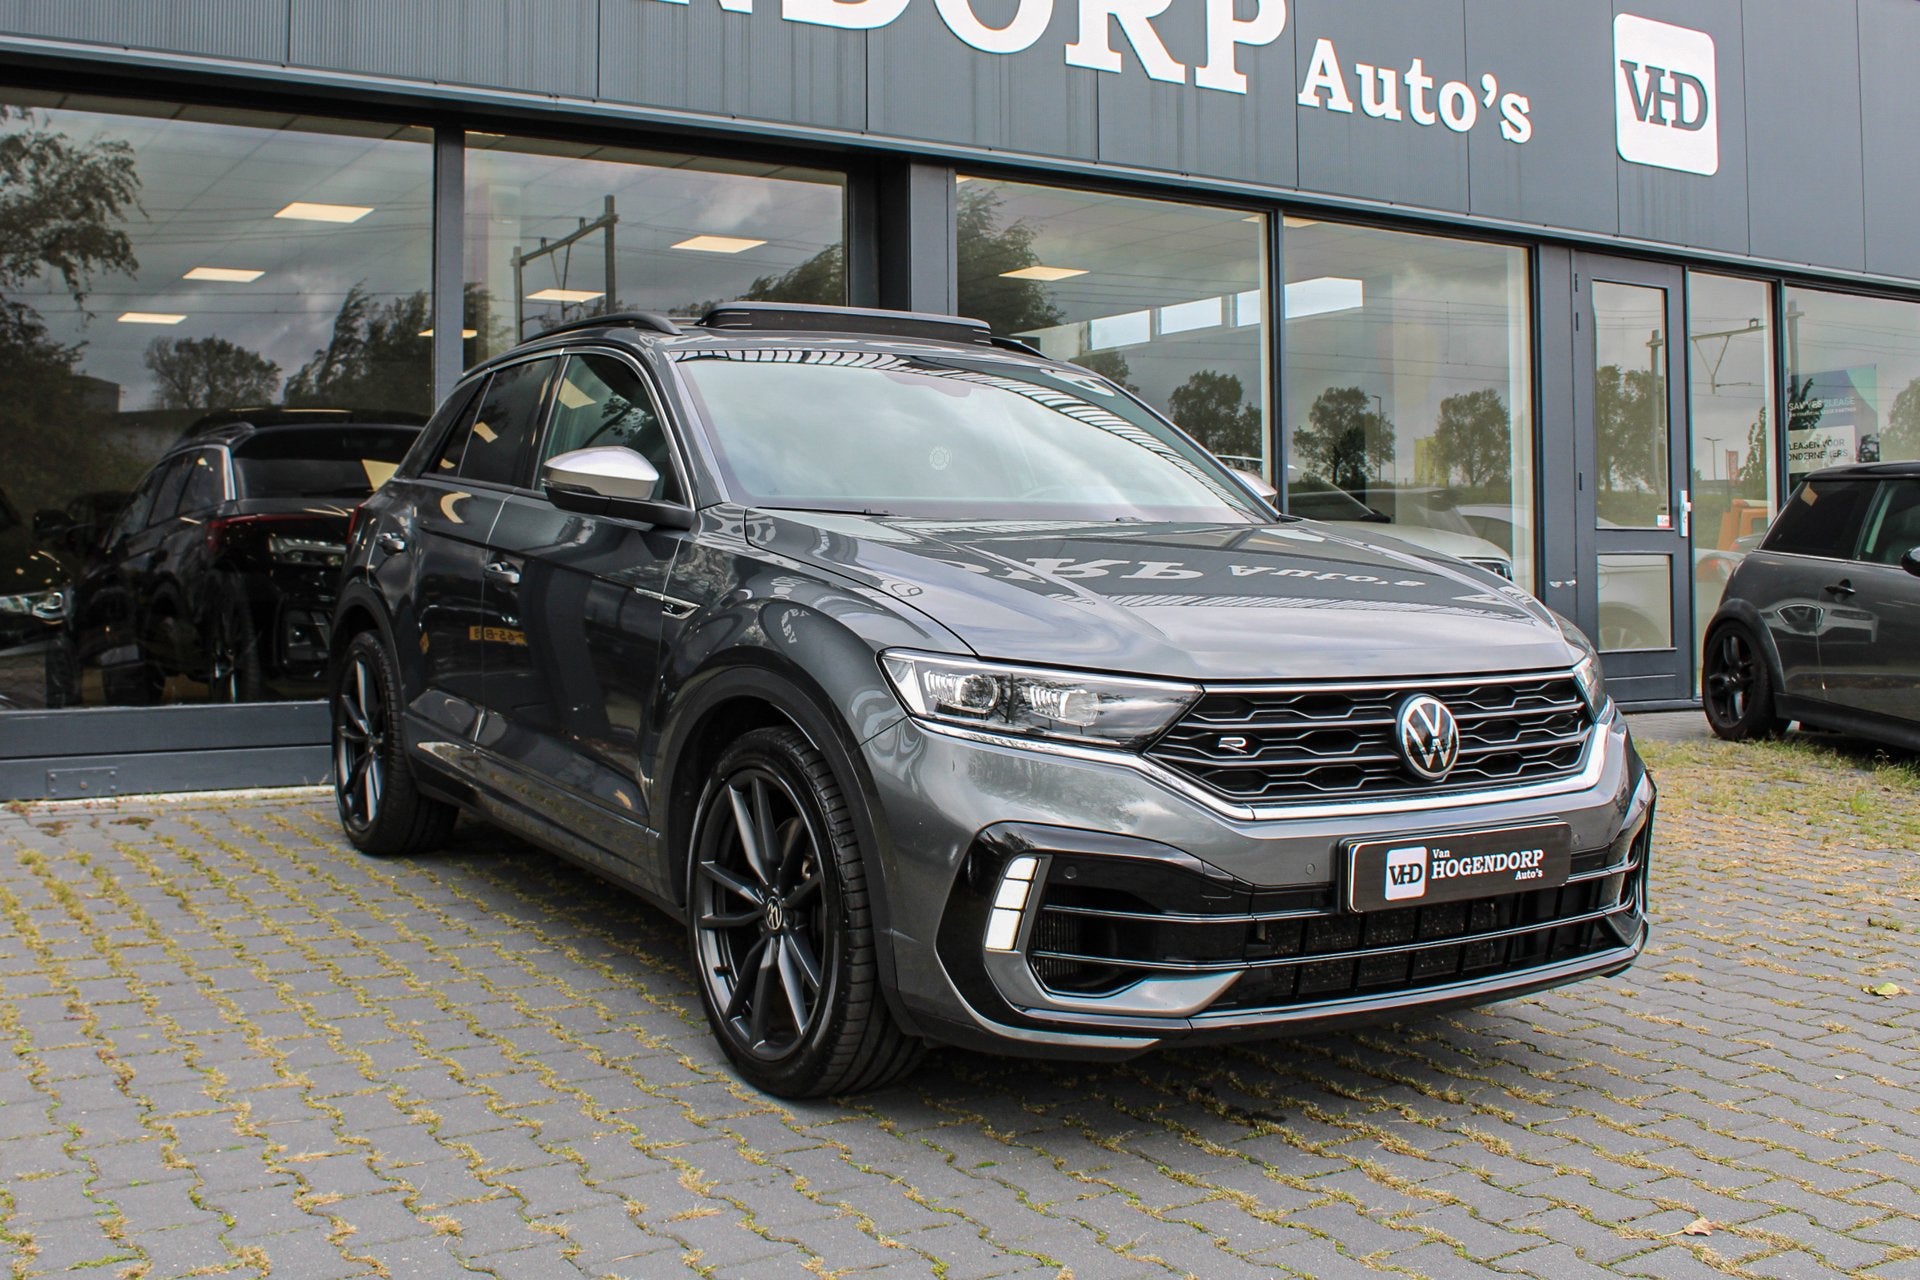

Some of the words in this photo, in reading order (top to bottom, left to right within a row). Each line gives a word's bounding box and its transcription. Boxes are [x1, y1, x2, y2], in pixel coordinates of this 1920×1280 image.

[1298, 38, 1532, 144] Auto's
[1619, 60, 1709, 132] VHD
[1431, 849, 1544, 880] HOGENDORP
[1432, 849, 1450, 859] Van
[1388, 862, 1423, 886] VHD
[1515, 868, 1543, 881] Auto's
